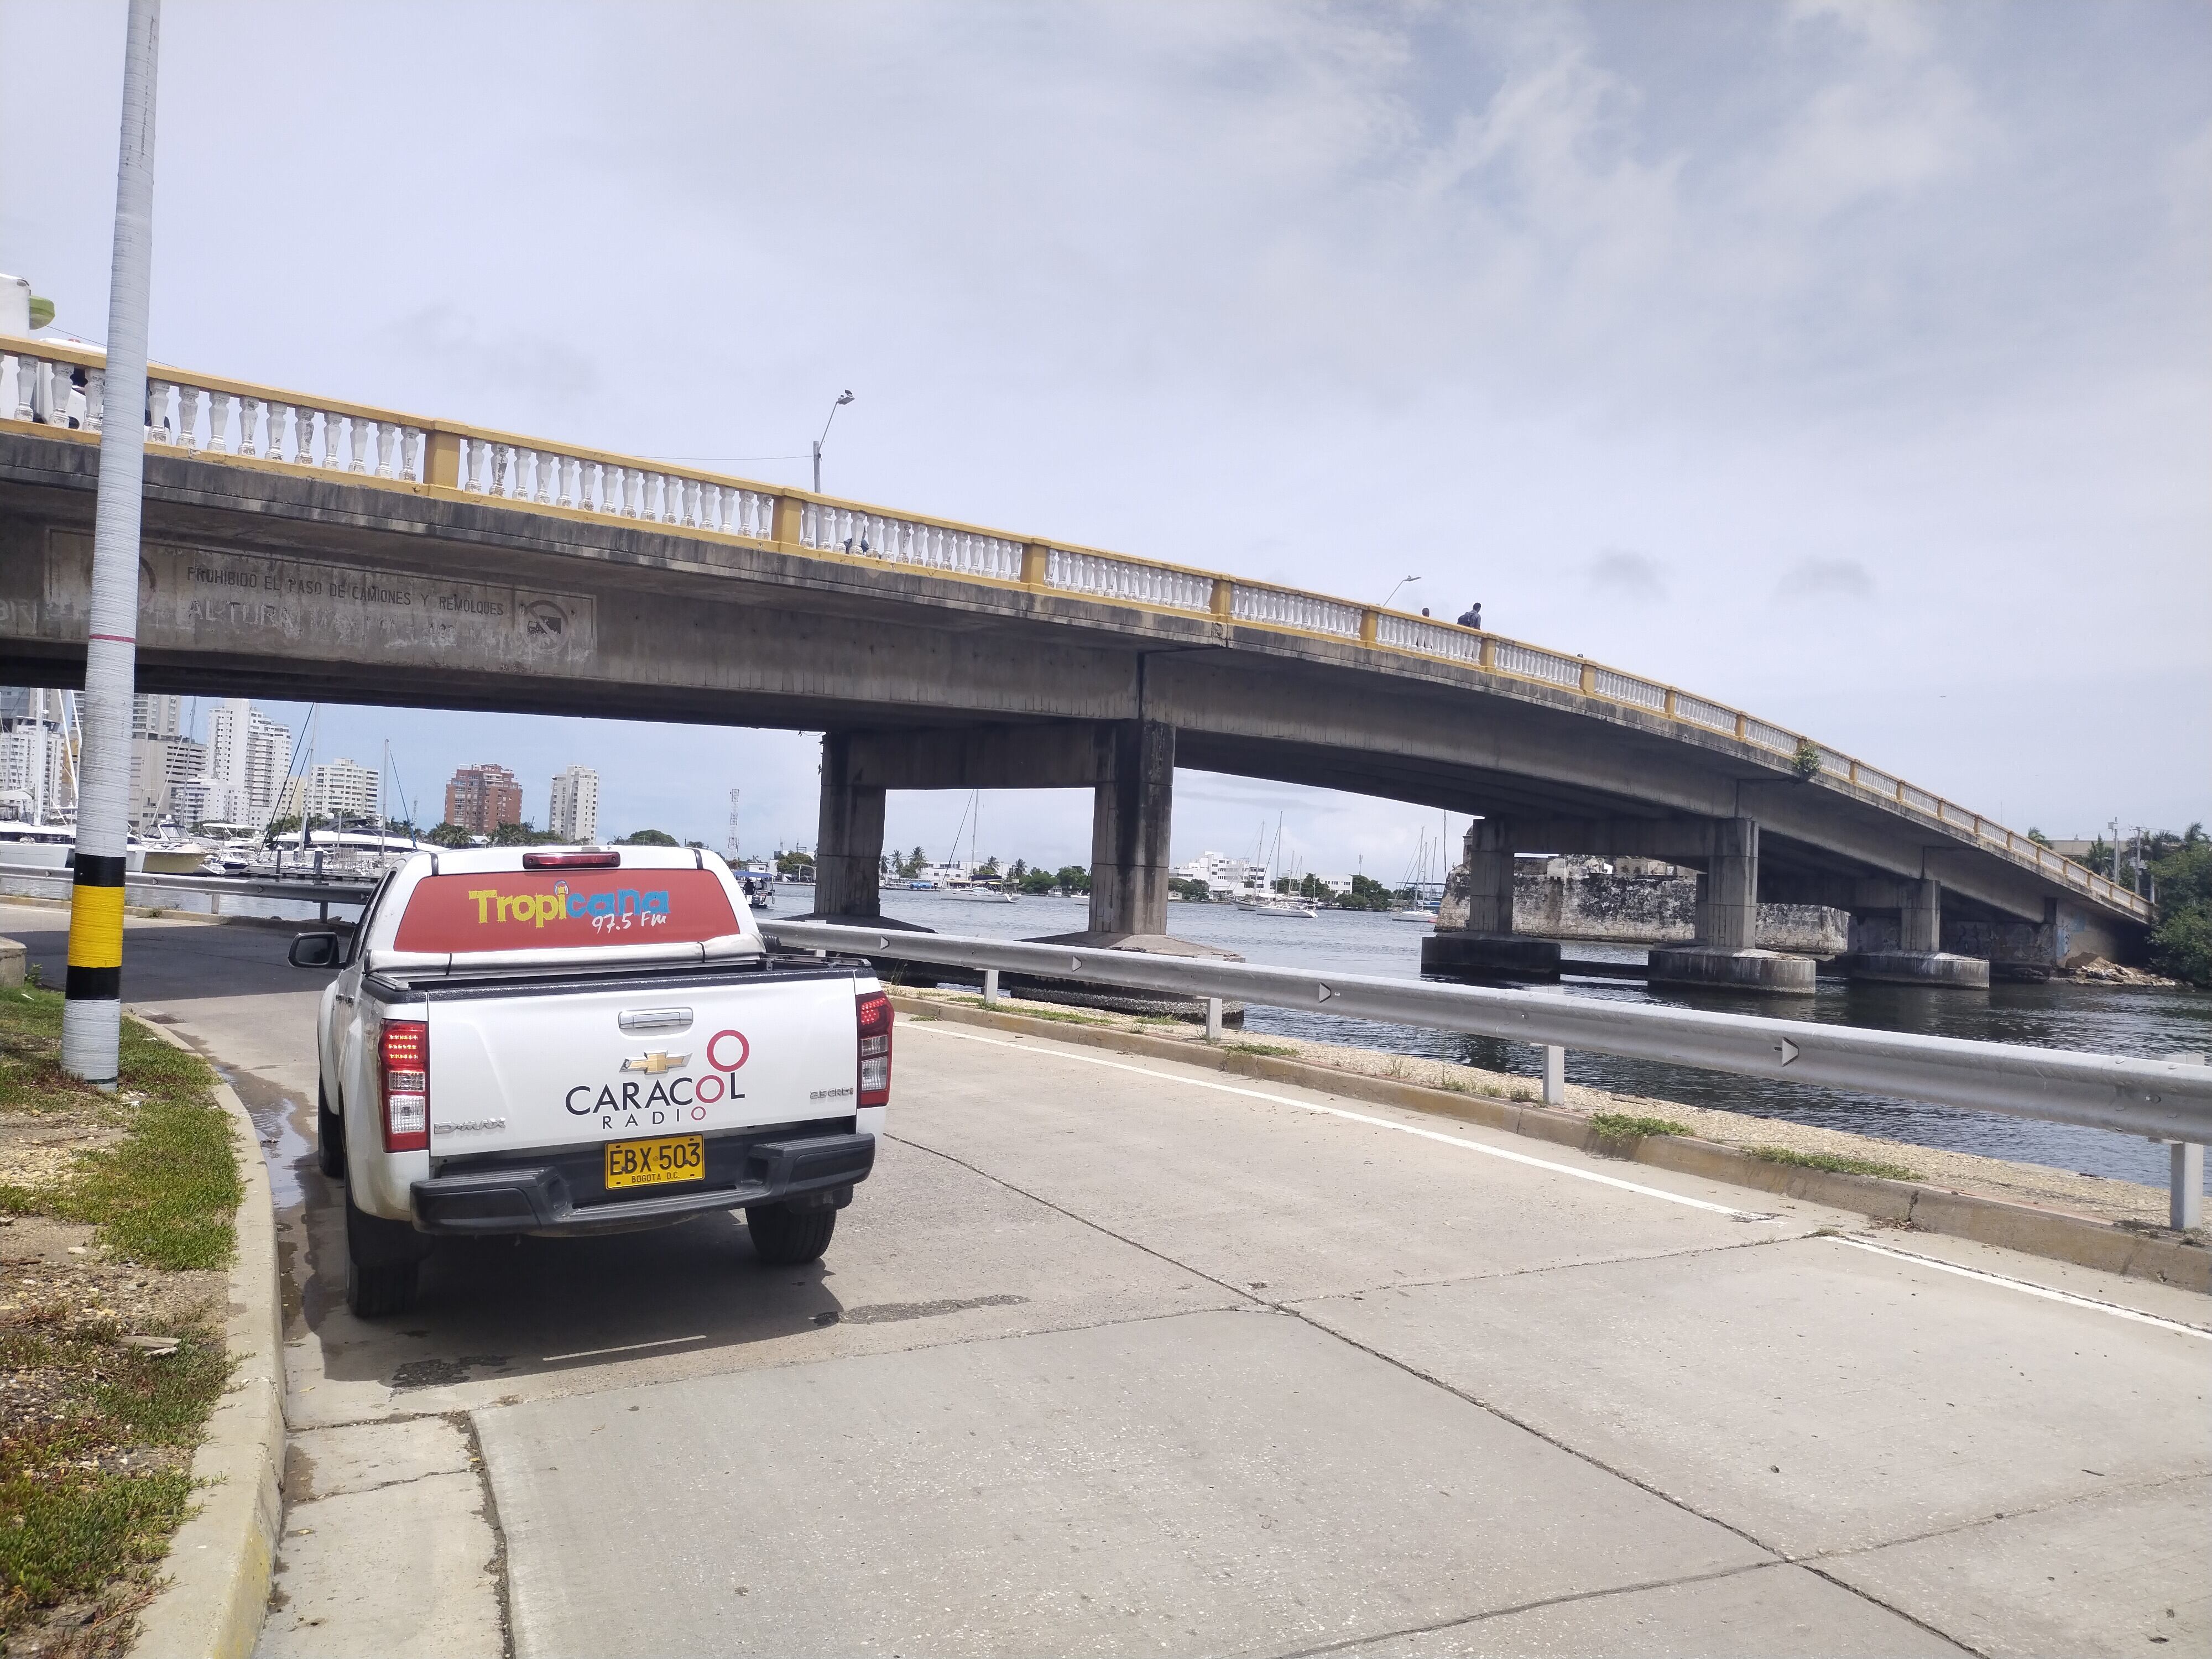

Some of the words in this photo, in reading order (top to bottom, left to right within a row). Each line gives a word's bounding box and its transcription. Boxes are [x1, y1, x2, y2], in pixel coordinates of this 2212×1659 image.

[187, 566, 257, 588] PROHIBIDO
[264, 576, 281, 591] EL
[288, 578, 322, 594] PASO
[330, 583, 346, 598] DE
[352, 586, 411, 606] CAMIONES
[421, 593, 429, 607] Y
[440, 596, 504, 616] REMOLQUES
[469, 885, 671, 928] Tropicana
[592, 913, 632, 934] 97.5
[565, 1072, 745, 1115] CARACOL
[602, 1106, 706, 1130] RADIO
[610, 1147, 651, 1176] EBX
[659, 1142, 700, 1170] 503
[632, 1173, 661, 1183] BOGOTA
